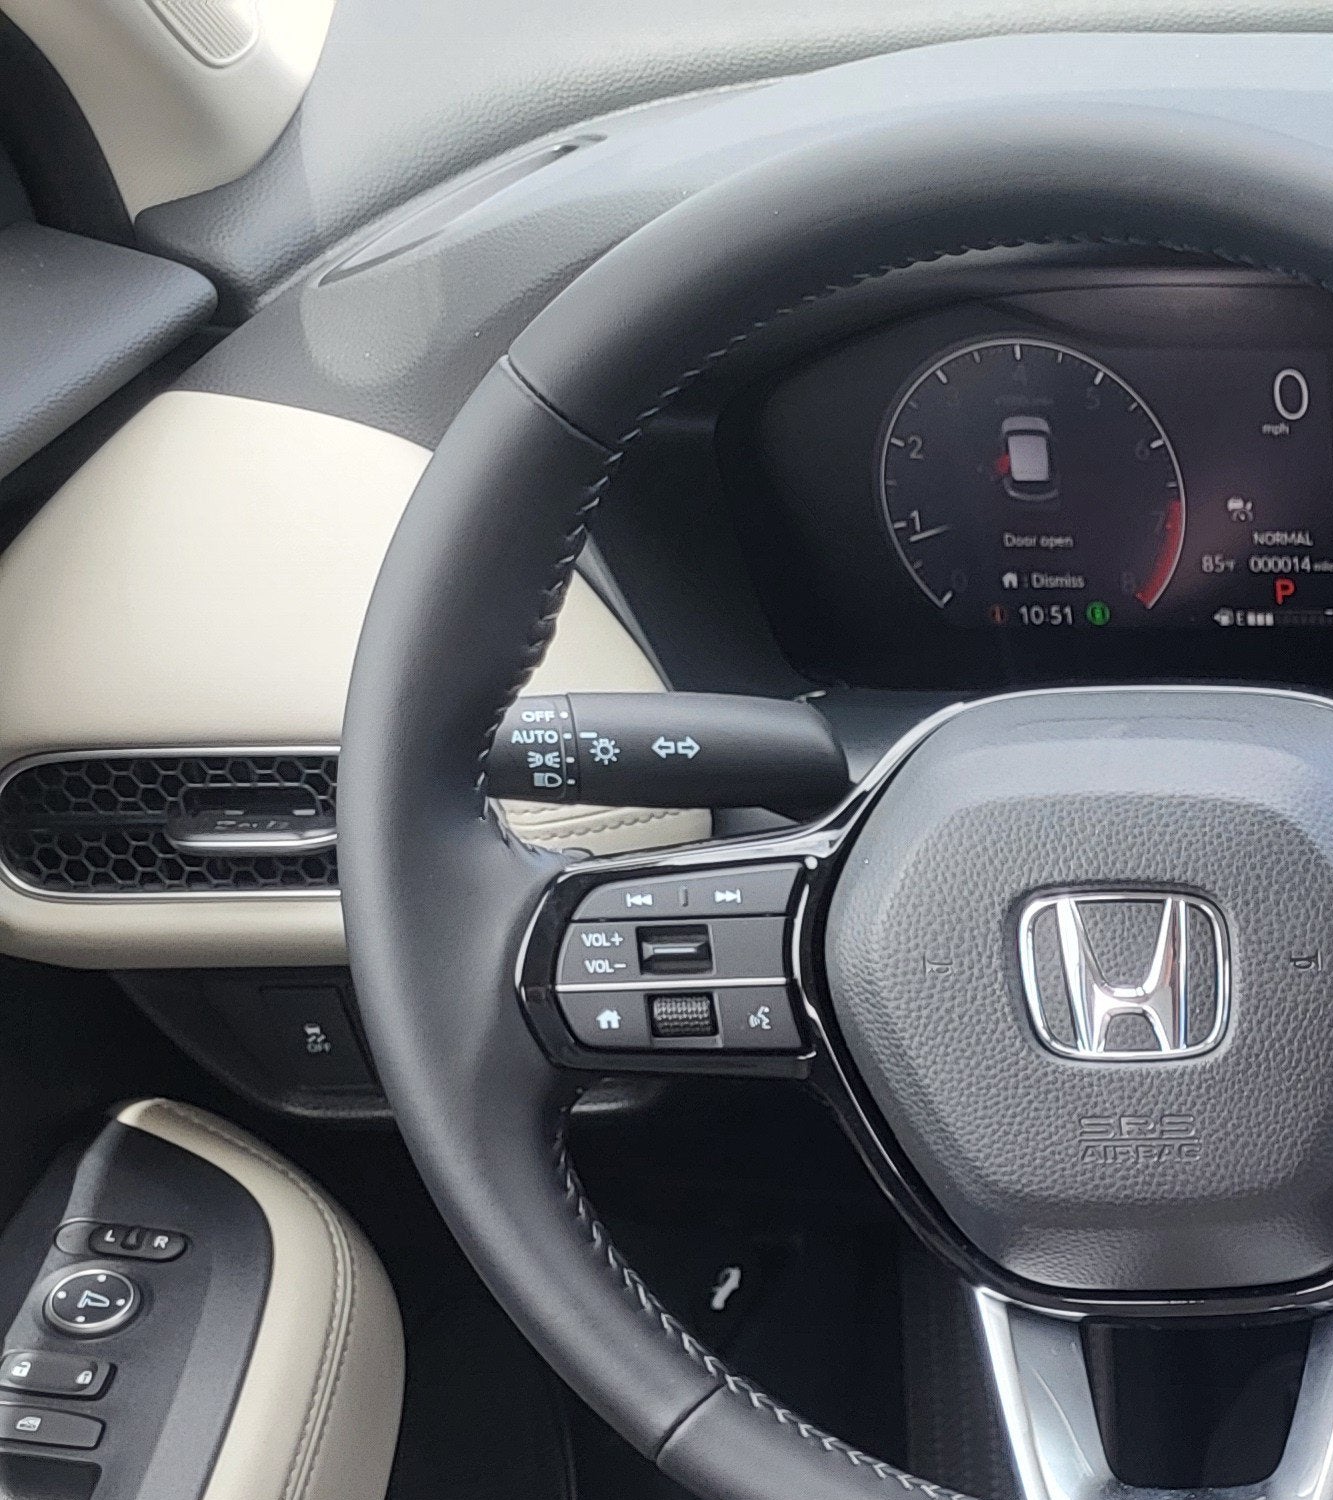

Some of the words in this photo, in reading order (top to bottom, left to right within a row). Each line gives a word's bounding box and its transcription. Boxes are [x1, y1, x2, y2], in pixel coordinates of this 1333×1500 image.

[1273, 368, 1309, 420] 0
[1262, 422, 1290, 436] mph
[907, 435, 924, 460] 2
[910, 510, 920, 532] 1
[1003, 533, 1037, 547] Door
[1040, 535, 1075, 549] open
[1253, 530, 1314, 547] NORMAL
[1250, 555, 1312, 574] 000014
[1031, 572, 1085, 589] Dismiss
[1273, 577, 1296, 605] P
[1018, 605, 1074, 626] 10:51
[521, 710, 555, 723] OFF
[511, 729, 559, 745] AUTO
[580, 931, 624, 948] VOL+
[584, 958, 627, 974] VOL-
[1077, 1114, 1197, 1139] SRS
[1080, 1144, 1200, 1164] AIRBAG
[103, 1230, 115, 1243] L
[153, 1234, 168, 1249] R
